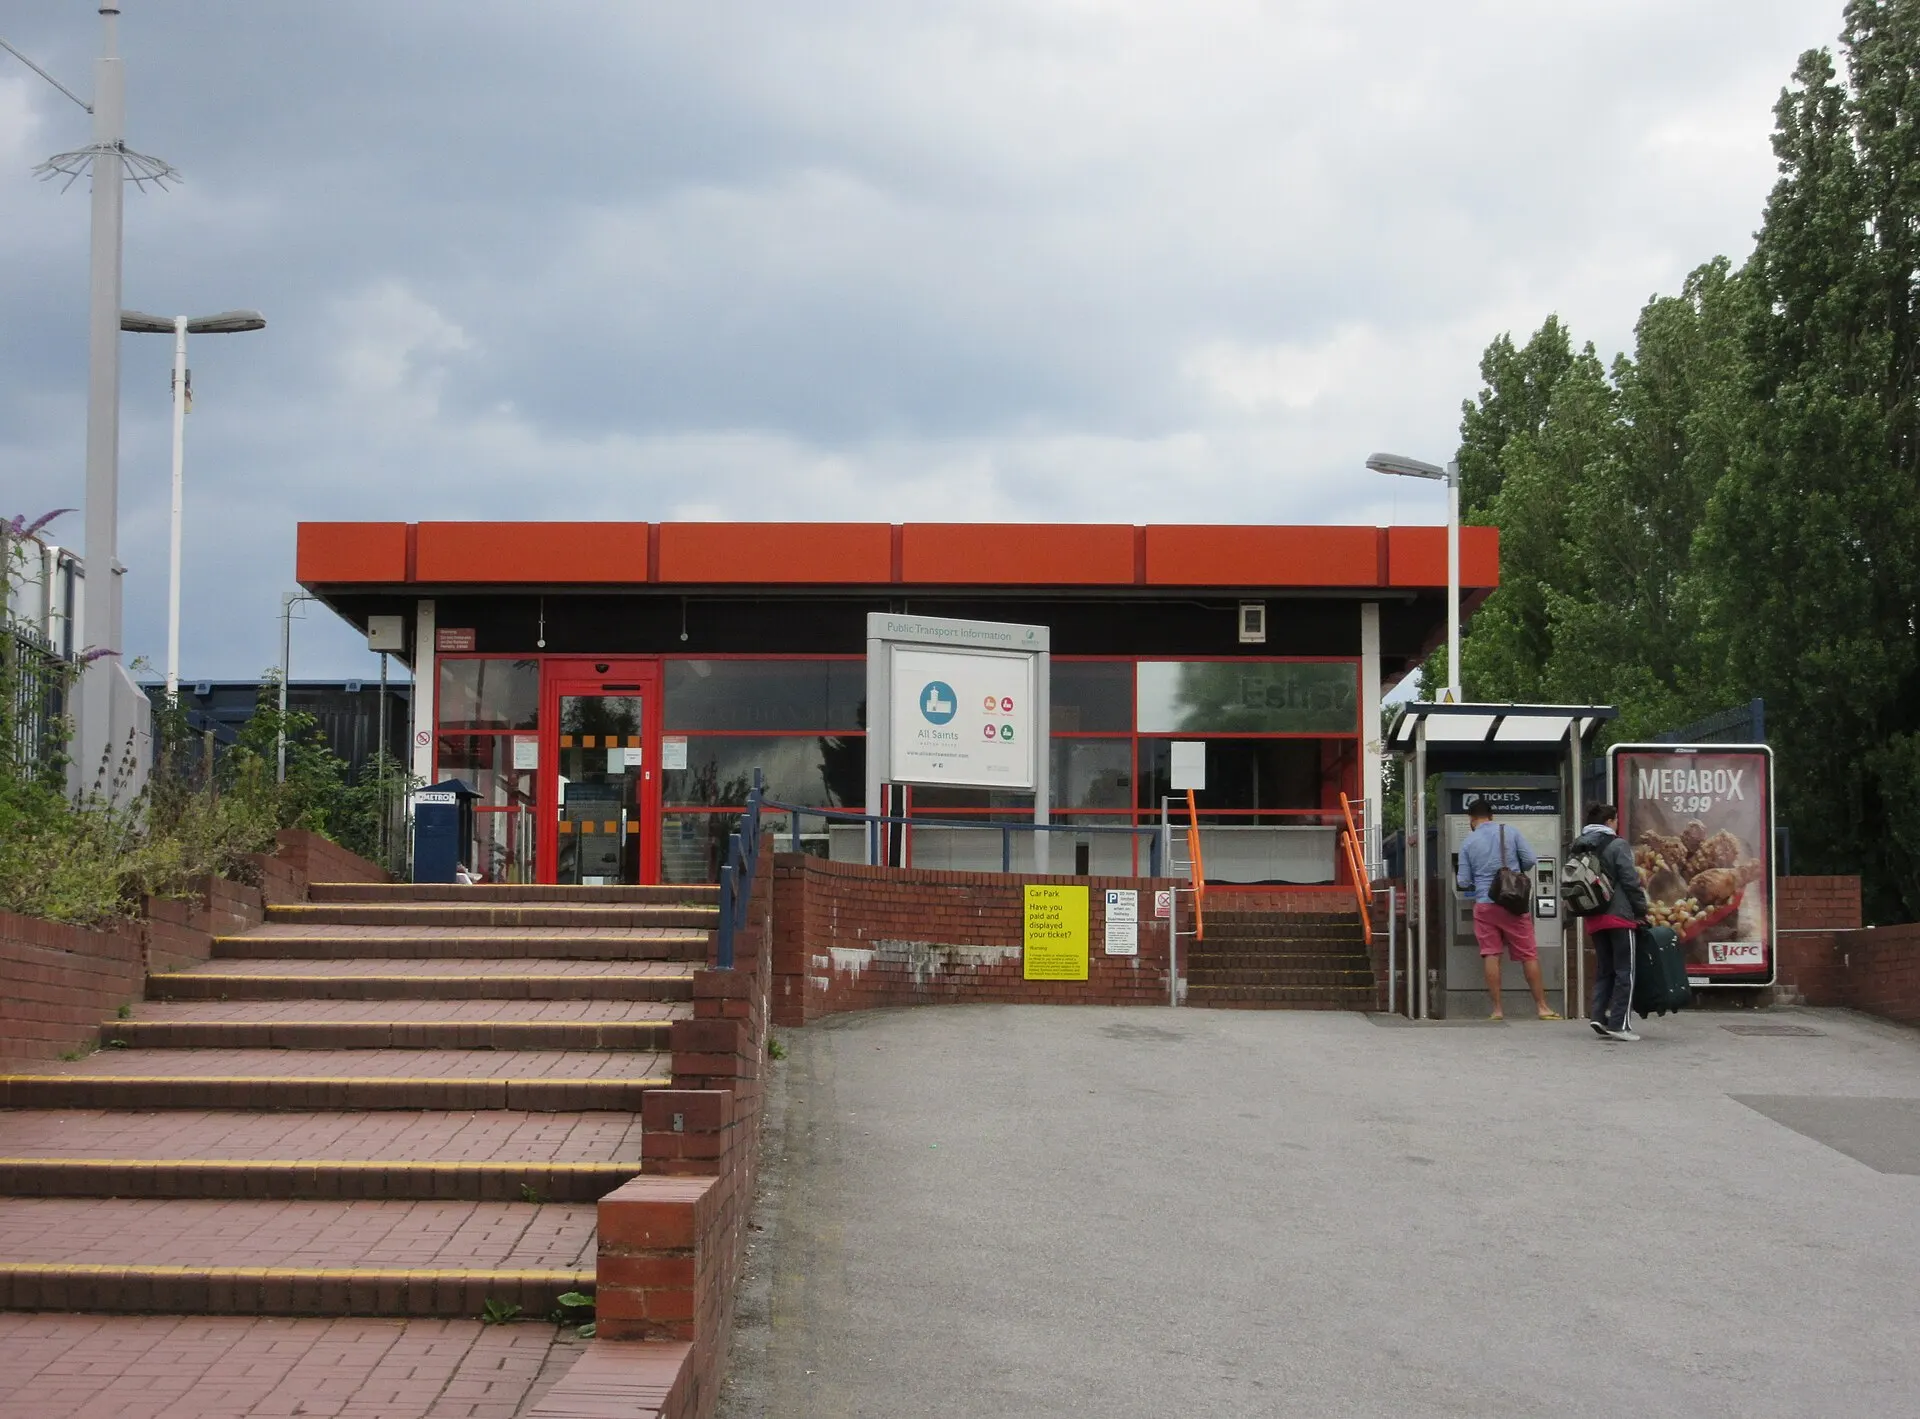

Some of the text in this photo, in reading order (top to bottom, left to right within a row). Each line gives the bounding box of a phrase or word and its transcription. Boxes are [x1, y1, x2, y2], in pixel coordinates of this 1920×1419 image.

[887, 622, 1012, 641] Public Transport Information
[918, 729, 959, 740] All Saints
[1638, 768, 1745, 800] MEGABOX
[424, 793, 450, 801] METRO
[1483, 793, 1520, 801] TICKETS
[1525, 804, 1554, 812] Payments
[1672, 796, 1712, 813] 3.99
[1109, 893, 1117, 903] P
[1029, 903, 1047, 911] Have
[1029, 913, 1044, 921] paid
[1029, 922, 1063, 930] displayed
[1729, 946, 1759, 956] KFC
